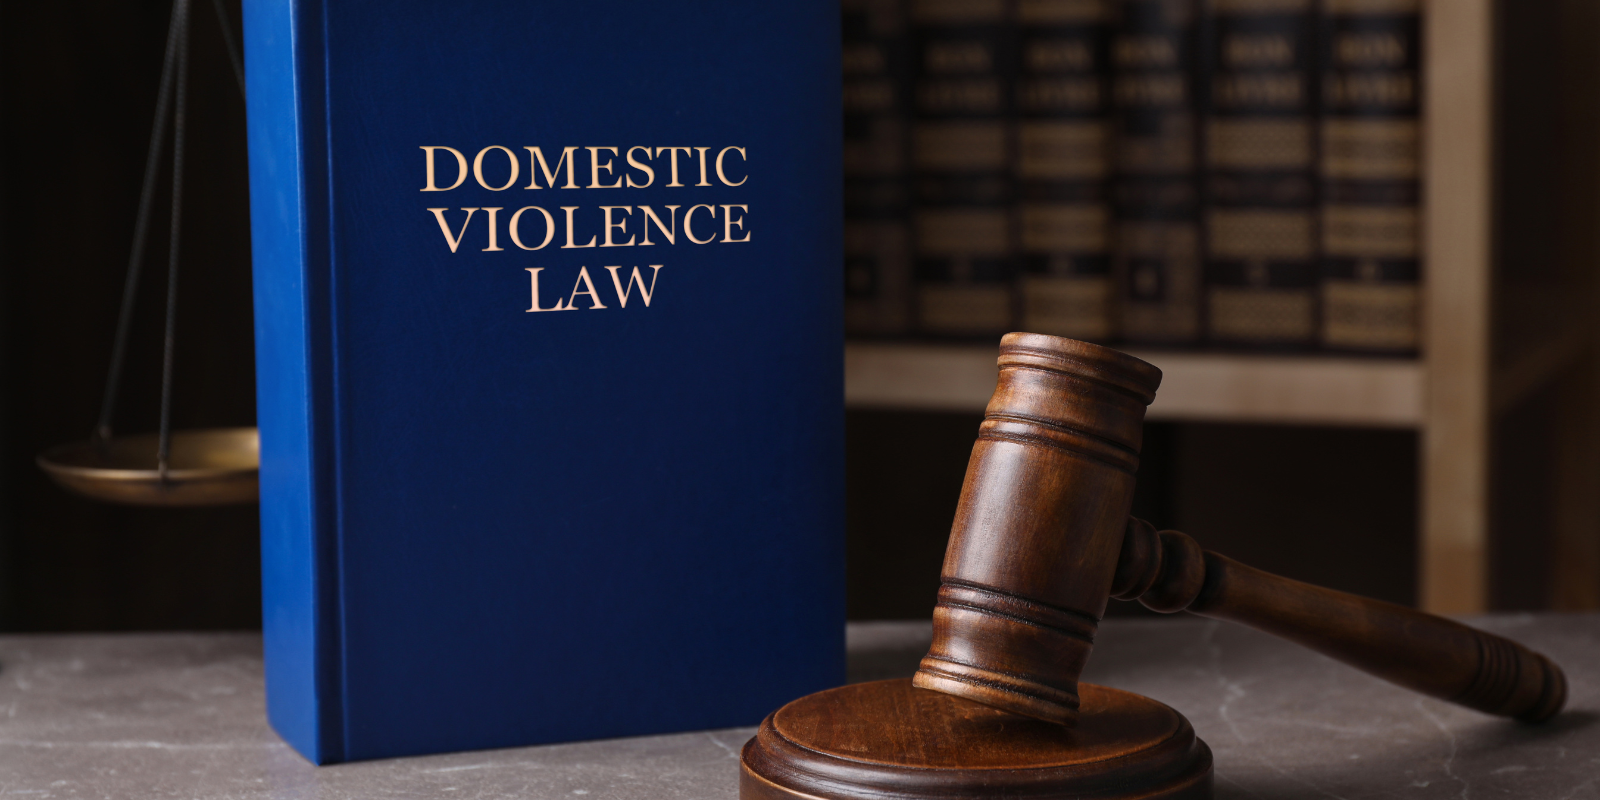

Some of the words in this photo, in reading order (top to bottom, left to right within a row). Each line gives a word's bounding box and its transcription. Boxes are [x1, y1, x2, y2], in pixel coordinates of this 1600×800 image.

[419, 145, 748, 192] DOMESTIC
[427, 203, 752, 253] VIOLENCE
[525, 264, 664, 313] LAW
